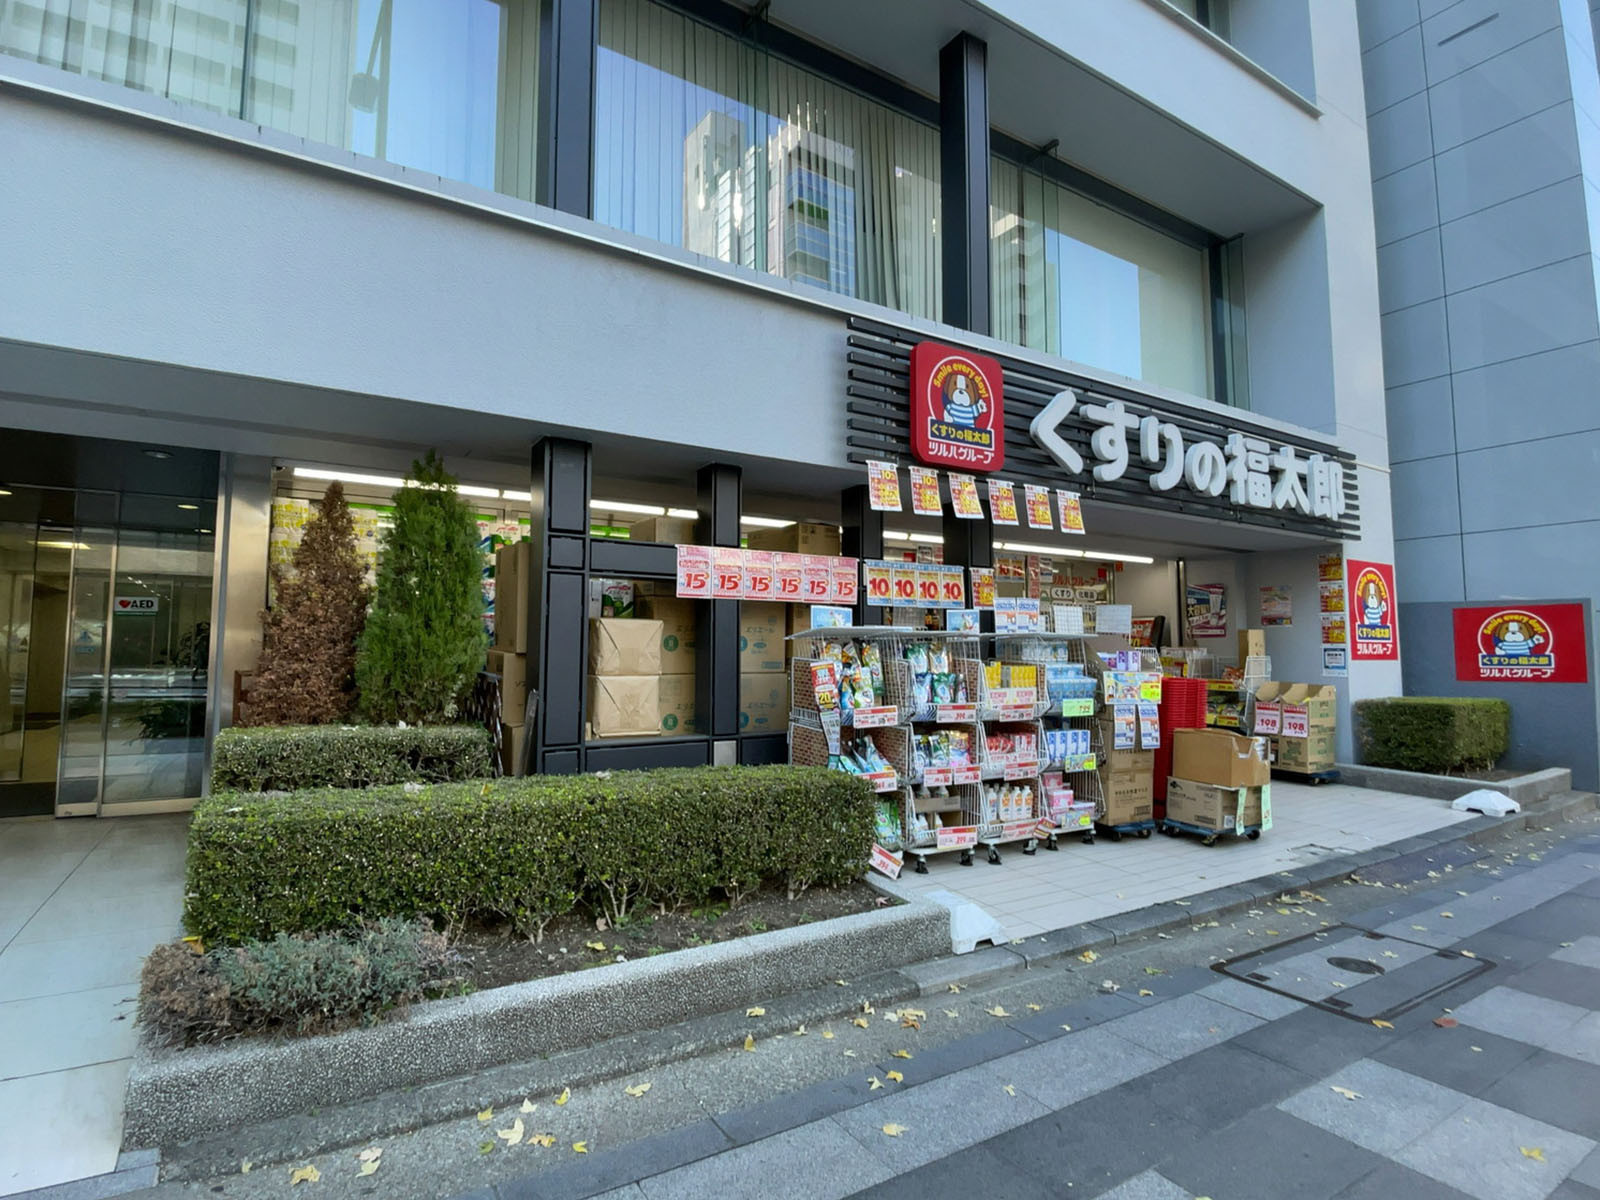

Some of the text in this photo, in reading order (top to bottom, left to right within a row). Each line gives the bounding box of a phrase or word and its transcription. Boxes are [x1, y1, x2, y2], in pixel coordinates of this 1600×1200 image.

[933, 363, 952, 388] Smile
[952, 362, 976, 378] every
[931, 423, 991, 445] くすりの福太郎
[928, 441, 995, 464] ツルハグループ
[1029, 387, 1345, 521] くすりの福太郎
[869, 577, 890, 596] 10
[895, 579, 914, 598] 10
[919, 581, 939, 599] 10
[943, 582, 962, 600] 10
[1054, 589, 1071, 598] くすり
[130, 600, 154, 609] AED
[1358, 627, 1391, 639] くすりの福太郎
[1483, 617, 1503, 635] Smile
[1503, 614, 1529, 624] every
[1356, 643, 1393, 655] ツルハグループ
[1482, 656, 1550, 665] くすりの福太郎
[1480, 668, 1555, 678] ツルハグループ
[1260, 718, 1277, 728] 198
[1287, 722, 1305, 731] 198
